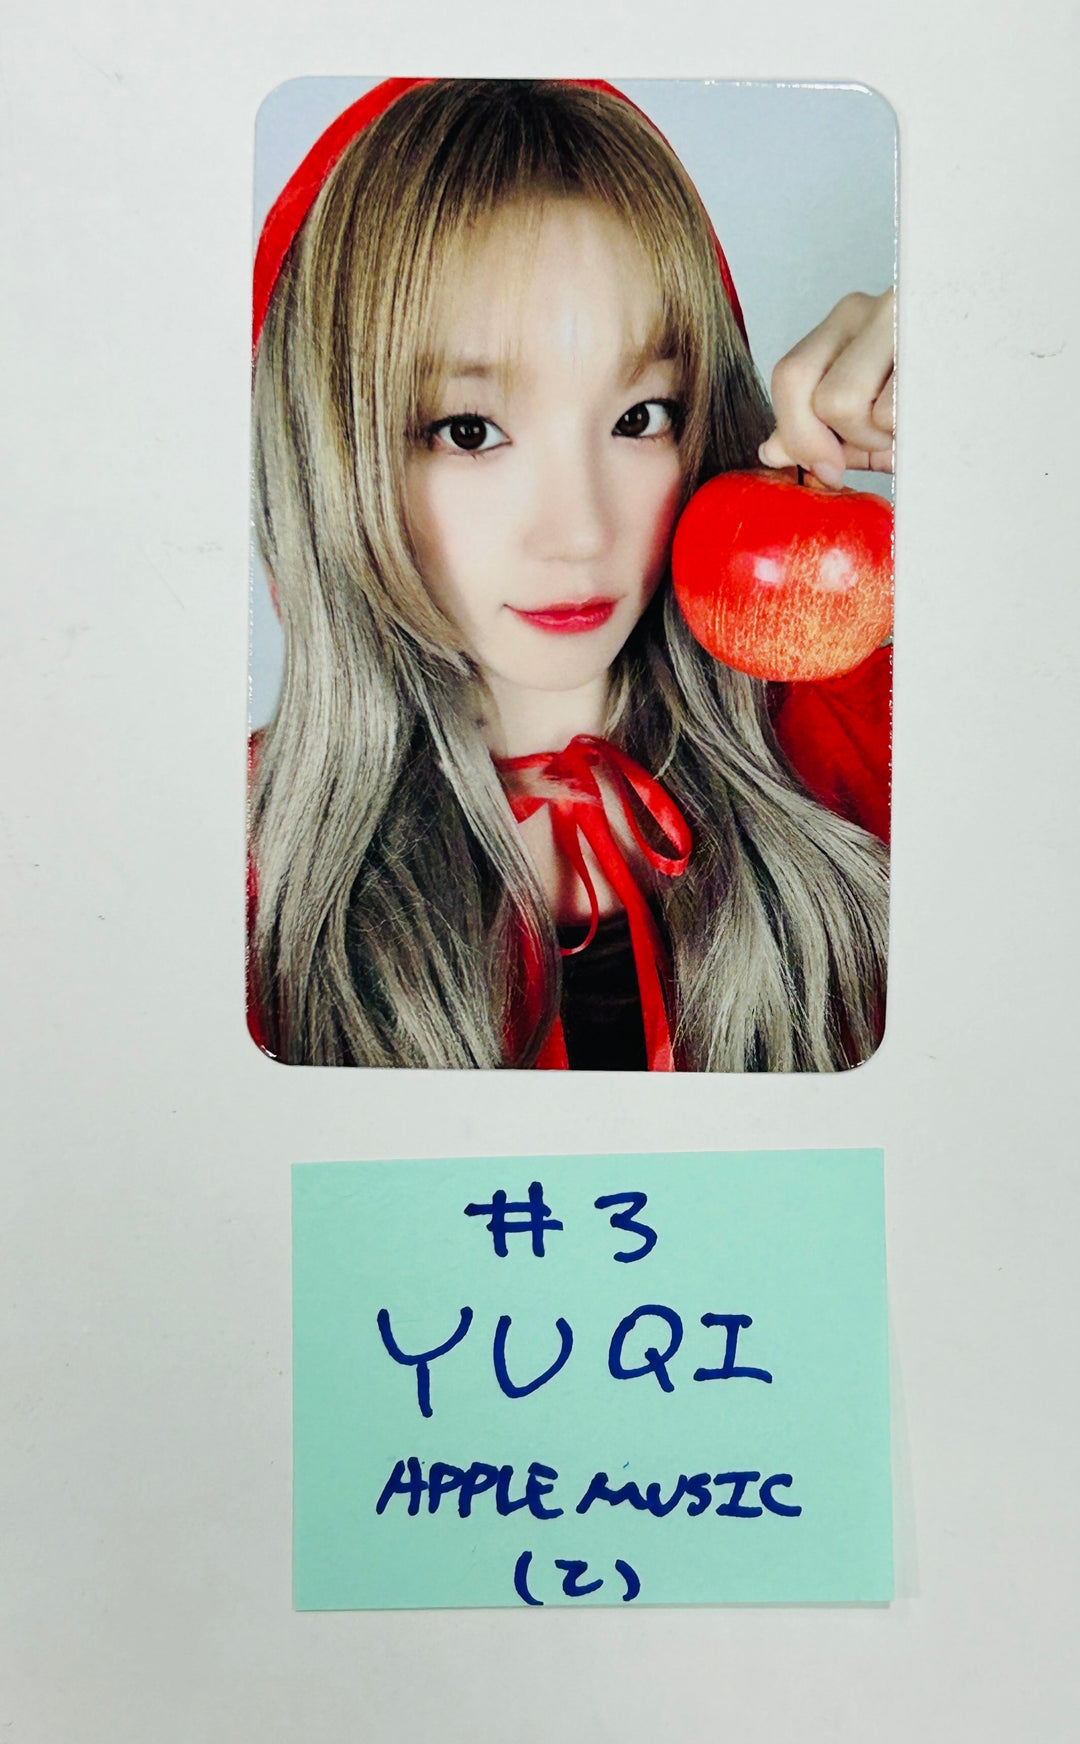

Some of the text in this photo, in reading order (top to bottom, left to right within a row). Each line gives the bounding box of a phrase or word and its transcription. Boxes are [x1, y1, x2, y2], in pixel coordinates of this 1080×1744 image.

[376, 1457, 803, 1521] APPLE MUSIC
[513, 1550, 642, 1606] (2)
